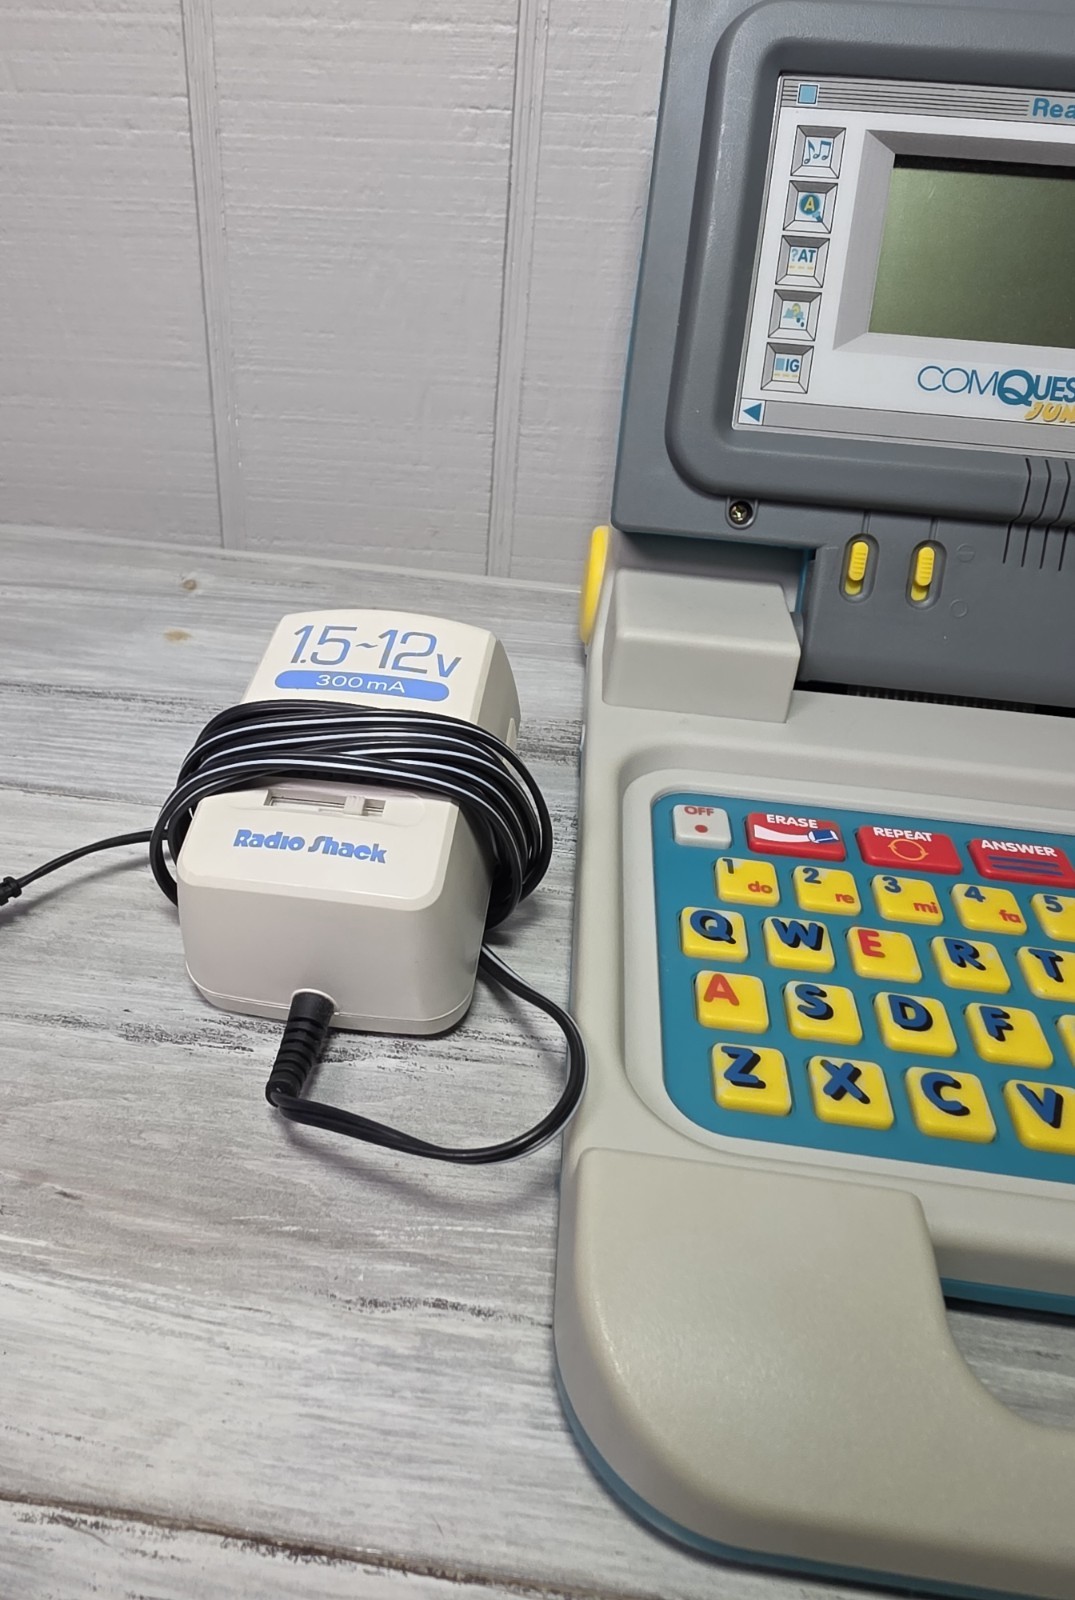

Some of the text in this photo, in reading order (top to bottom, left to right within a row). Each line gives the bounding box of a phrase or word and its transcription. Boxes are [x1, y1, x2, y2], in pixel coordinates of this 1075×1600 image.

[1032, 97, 1075, 118] Rea
[315, 674, 406, 694] 300 mA
[684, 805, 714, 817] OFF
[766, 813, 818, 829] ERASE
[873, 827, 933, 843] REPEAT
[233, 829, 387, 864] Radio Shack
[981, 839, 1057, 858] ANSWER
[722, 858, 735, 875] 1
[803, 867, 822, 885] 2
[747, 880, 773, 894] do
[882, 876, 902, 894] 3
[964, 886, 986, 903] 4
[835, 891, 855, 905] re
[913, 900, 939, 915] mi
[1043, 895, 1063, 913] 5
[999, 908, 1022, 924] fa
[690, 910, 736, 944] Q
[771, 918, 823, 950] W
[858, 929, 885, 958] E
[944, 938, 986, 970] R
[1029, 948, 1065, 983] T
[703, 973, 740, 1006] A
[795, 984, 834, 1021] S
[888, 994, 933, 1032] D
[980, 1006, 1013, 1042] F
[721, 1045, 766, 1089] Z
[820, 1059, 871, 1104] X
[921, 1072, 970, 1116] C
[1016, 1083, 1064, 1129] V
